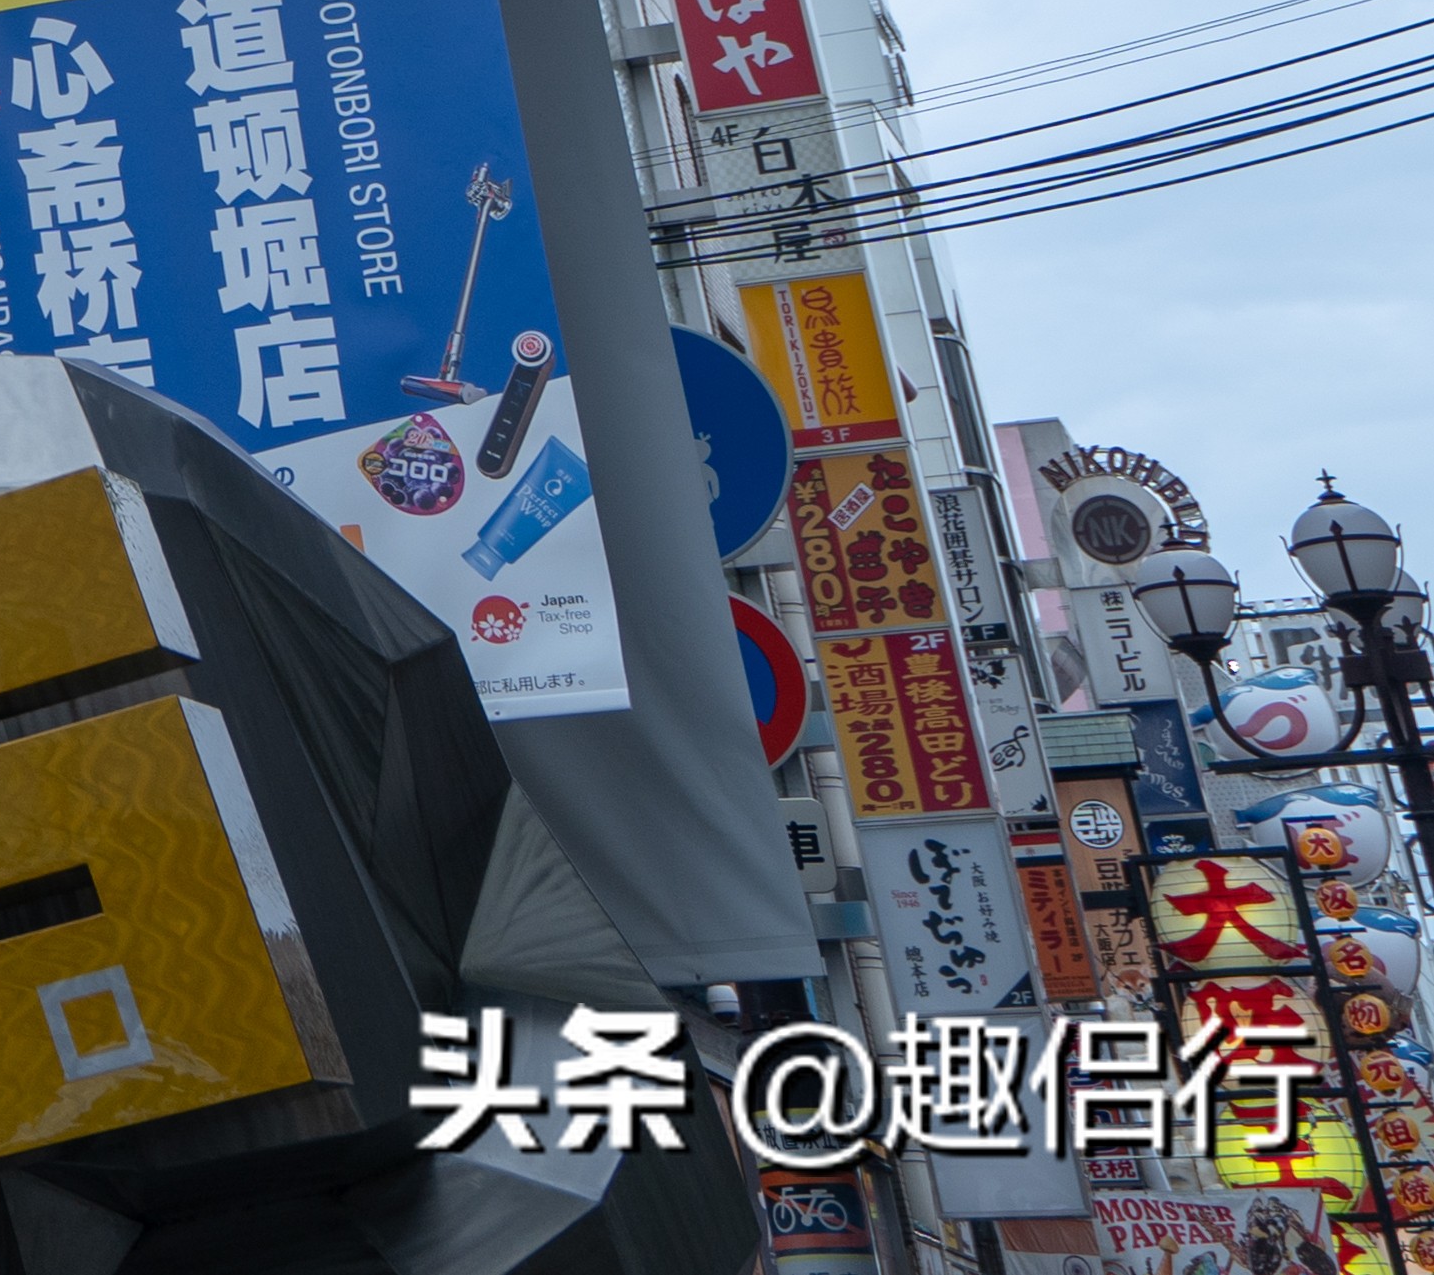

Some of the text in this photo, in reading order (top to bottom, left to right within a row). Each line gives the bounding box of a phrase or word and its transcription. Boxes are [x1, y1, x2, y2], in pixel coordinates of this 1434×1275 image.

[711, 124, 739, 148] 4F
[752, 126, 840, 264] 白木屋
[347, 179, 403, 297] STORE
[801, 285, 862, 418] 鳥貴族
[389, 456, 449, 485] コロロ
[1038, 444, 1160, 494] NIKOH
[515, 483, 559, 519] Perfect
[520, 497, 552, 528] Whip
[831, 486, 874, 527] 居酒屋
[794, 482, 844, 606] ¥280
[867, 453, 936, 620] たこやき
[1087, 513, 1136, 548] NK
[936, 494, 985, 623] 浪花囲碁サロン
[536, 608, 592, 625] Tax-free
[558, 620, 593, 636] Shop
[909, 632, 946, 651] 2F
[827, 662, 897, 716] 酒場
[902, 652, 973, 807] 豊後高田どり
[855, 733, 904, 802] 280
[890, 888, 919, 901] Since
[908, 838, 986, 995] ぼてぢゅう
[970, 862, 1001, 944] 大阪 お好み焼
[1027, 869, 1063, 974] ミティラー
[1093, 923, 1118, 967] 大阪店
[1010, 990, 1033, 1005] 2F
[1092, 1197, 1236, 1226] MONSTER
